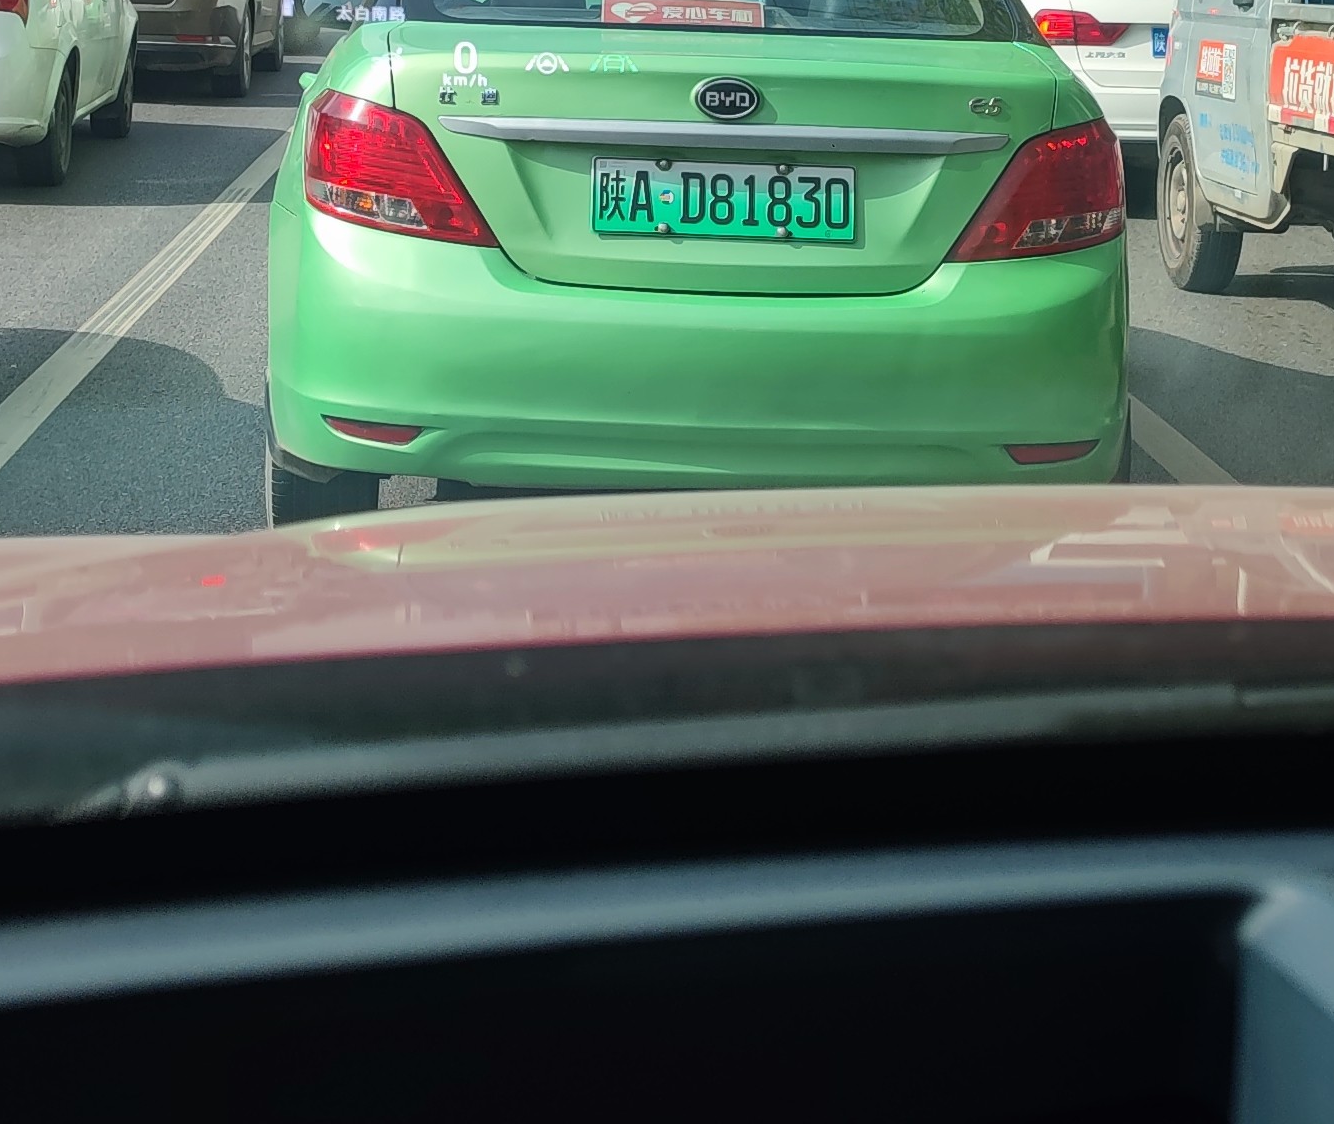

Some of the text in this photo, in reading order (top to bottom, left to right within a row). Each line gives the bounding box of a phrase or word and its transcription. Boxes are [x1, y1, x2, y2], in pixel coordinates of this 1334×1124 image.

[453, 41, 478, 74] 0
[442, 73, 488, 88] km/h
[705, 92, 750, 107] BYD
